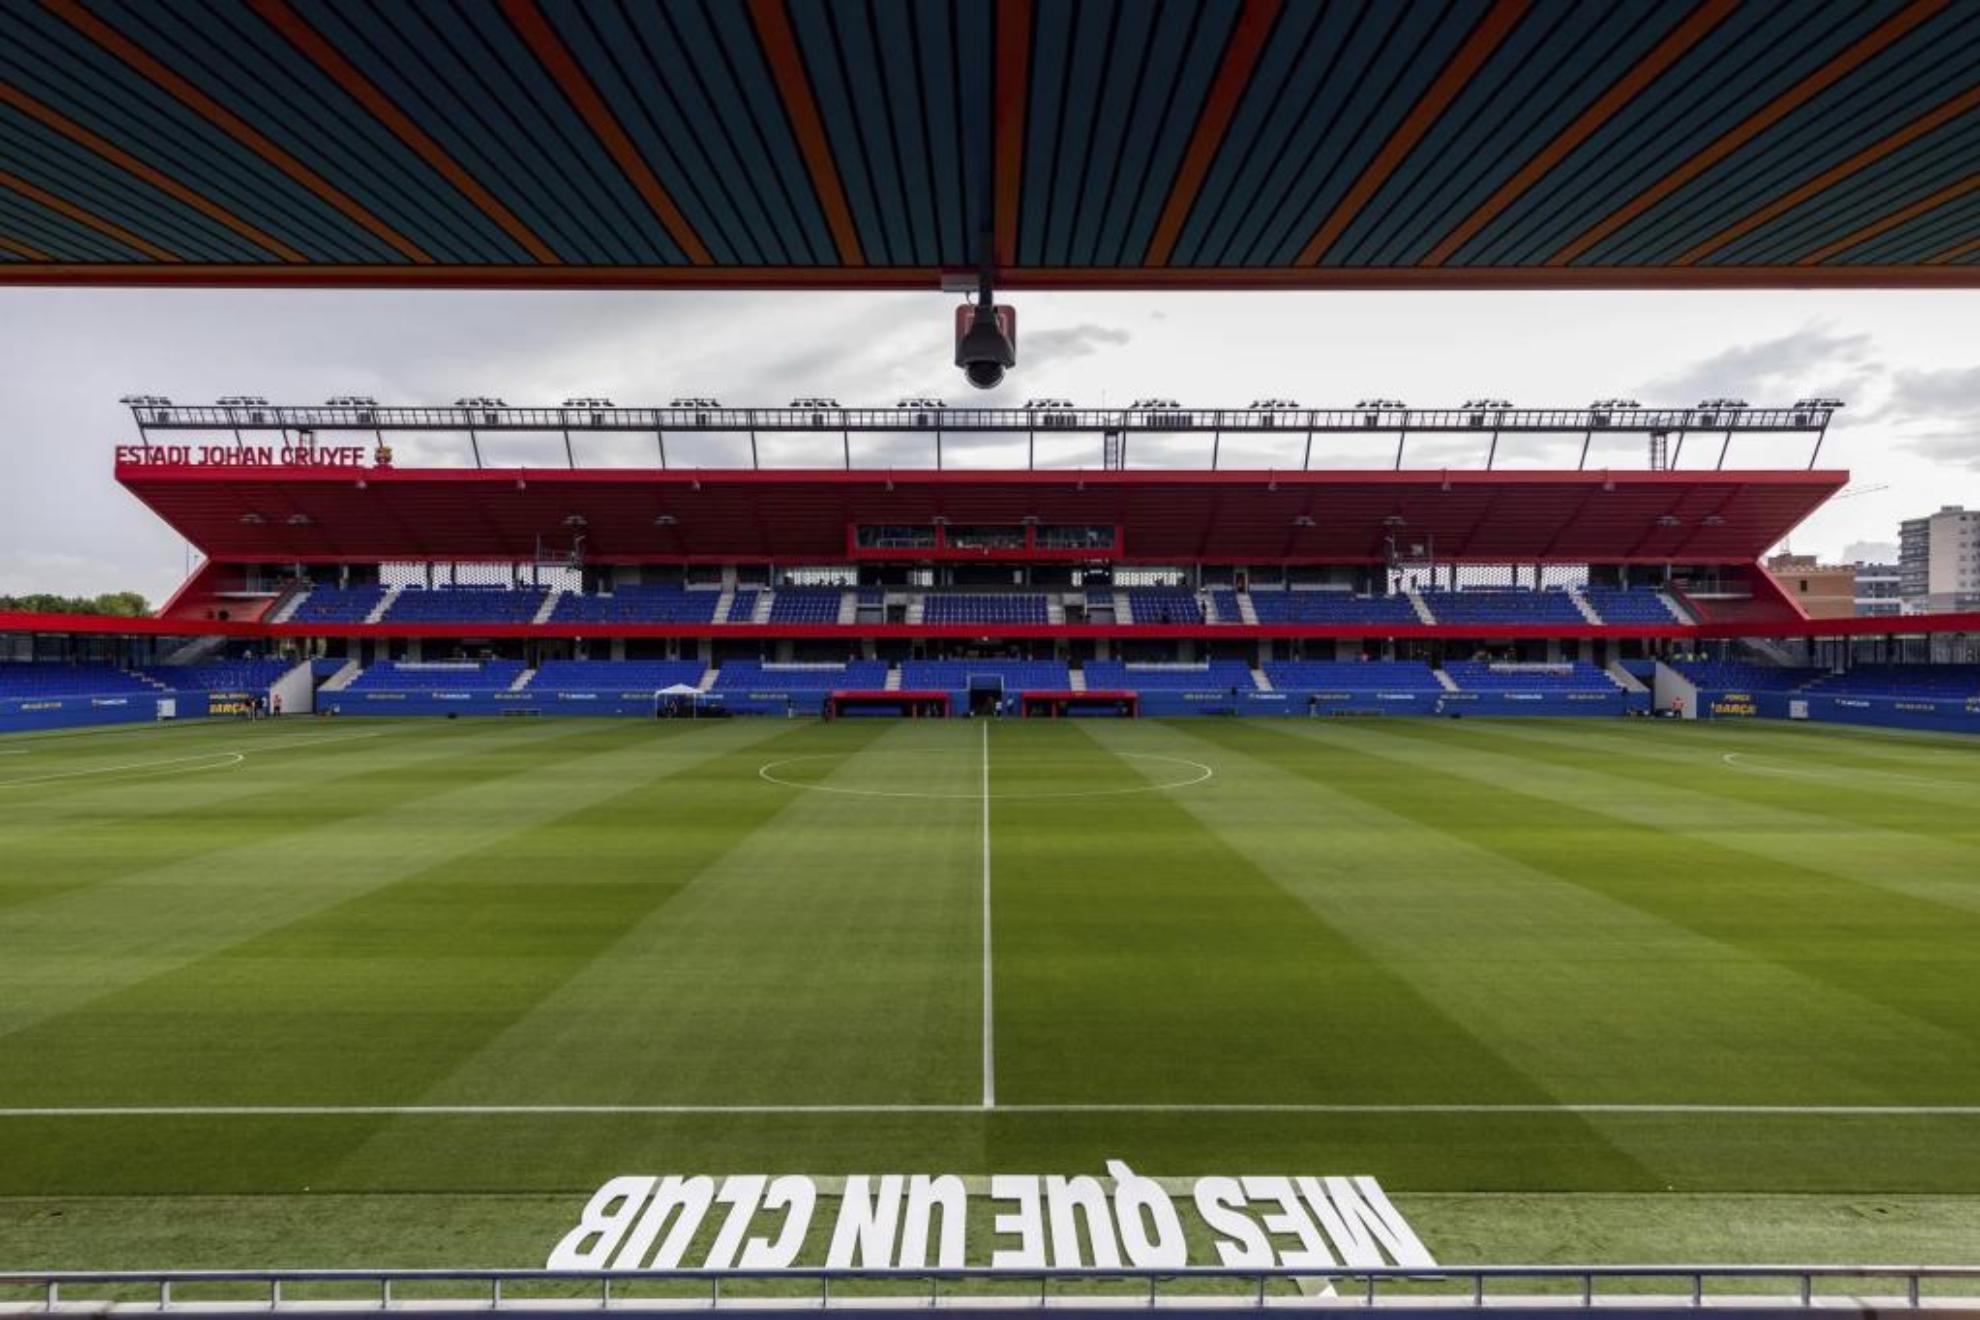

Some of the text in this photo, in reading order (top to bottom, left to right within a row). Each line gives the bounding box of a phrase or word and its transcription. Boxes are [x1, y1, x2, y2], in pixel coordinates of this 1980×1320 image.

[116, 446, 365, 466] ESTADI JOHAN CRUYFF
[545, 1174, 817, 1270] CLUB
[825, 1174, 967, 1269] UN
[991, 1160, 1187, 1269] QUE
